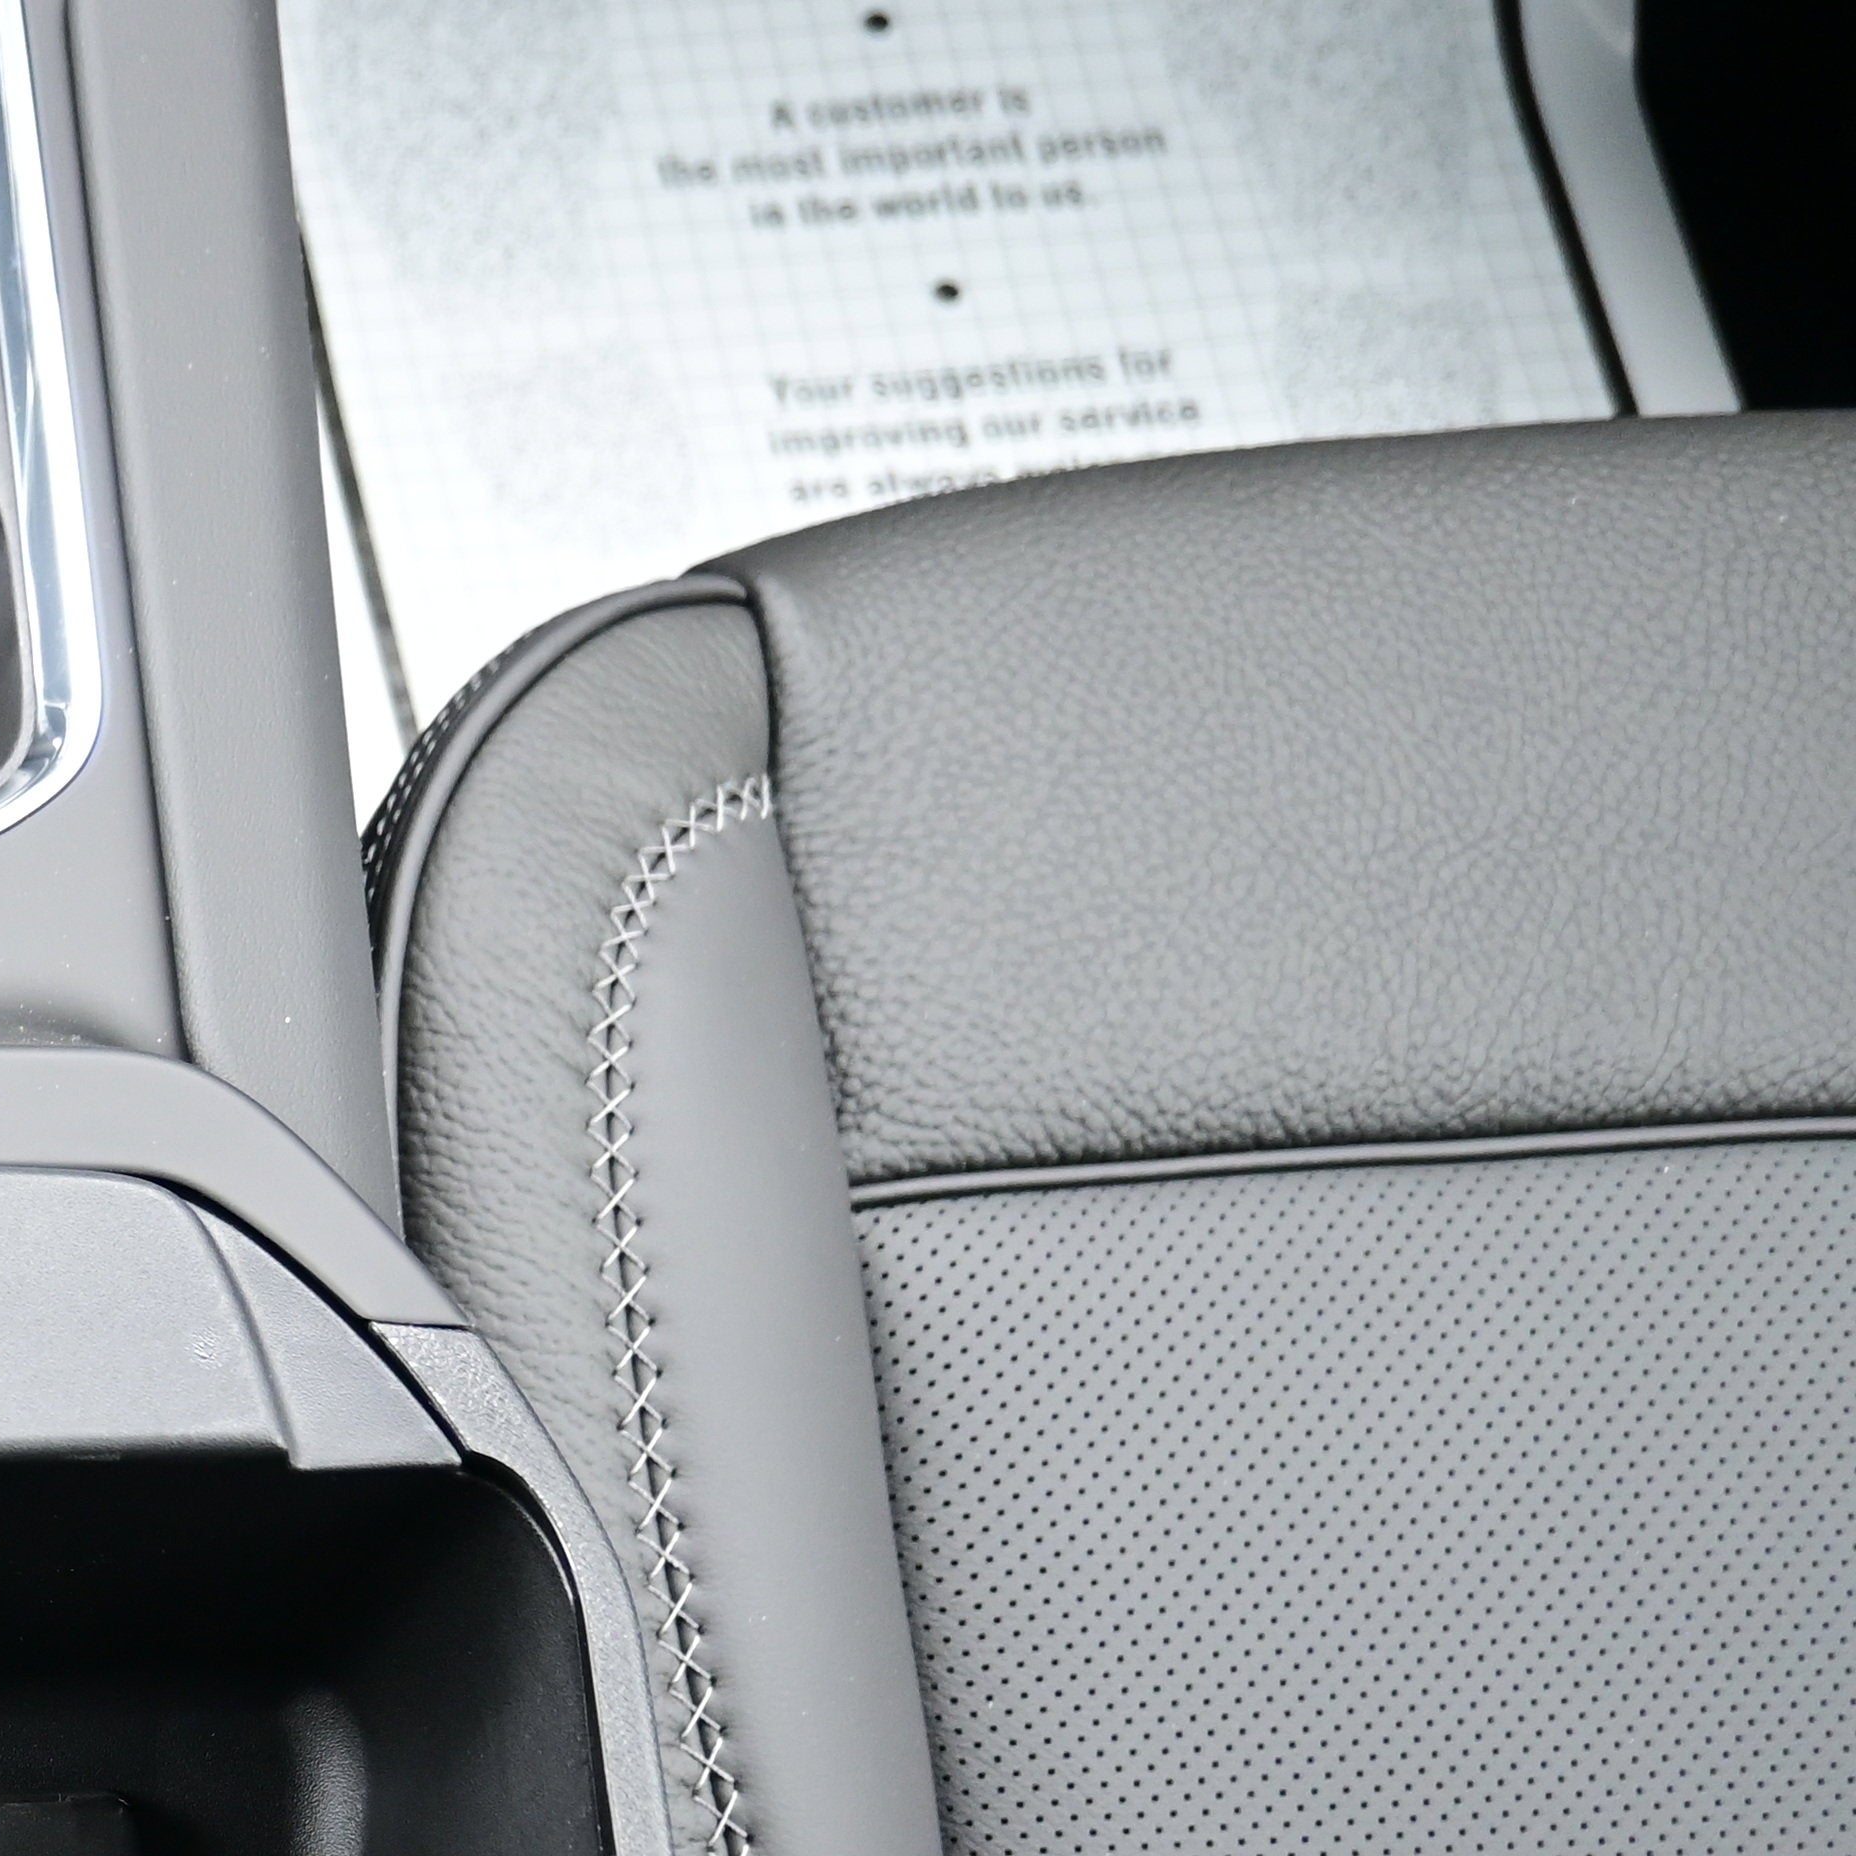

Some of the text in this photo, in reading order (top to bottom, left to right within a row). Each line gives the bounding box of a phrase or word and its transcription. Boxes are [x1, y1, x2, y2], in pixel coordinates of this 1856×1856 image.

[770, 100, 796, 132] A
[804, 88, 986, 128] customer
[656, 127, 1169, 188] the most important person
[797, 194, 859, 227] the
[871, 182, 980, 221] world
[991, 182, 1029, 212] to
[767, 347, 1173, 406] Your suggestions for
[769, 397, 1201, 457] improving our service
